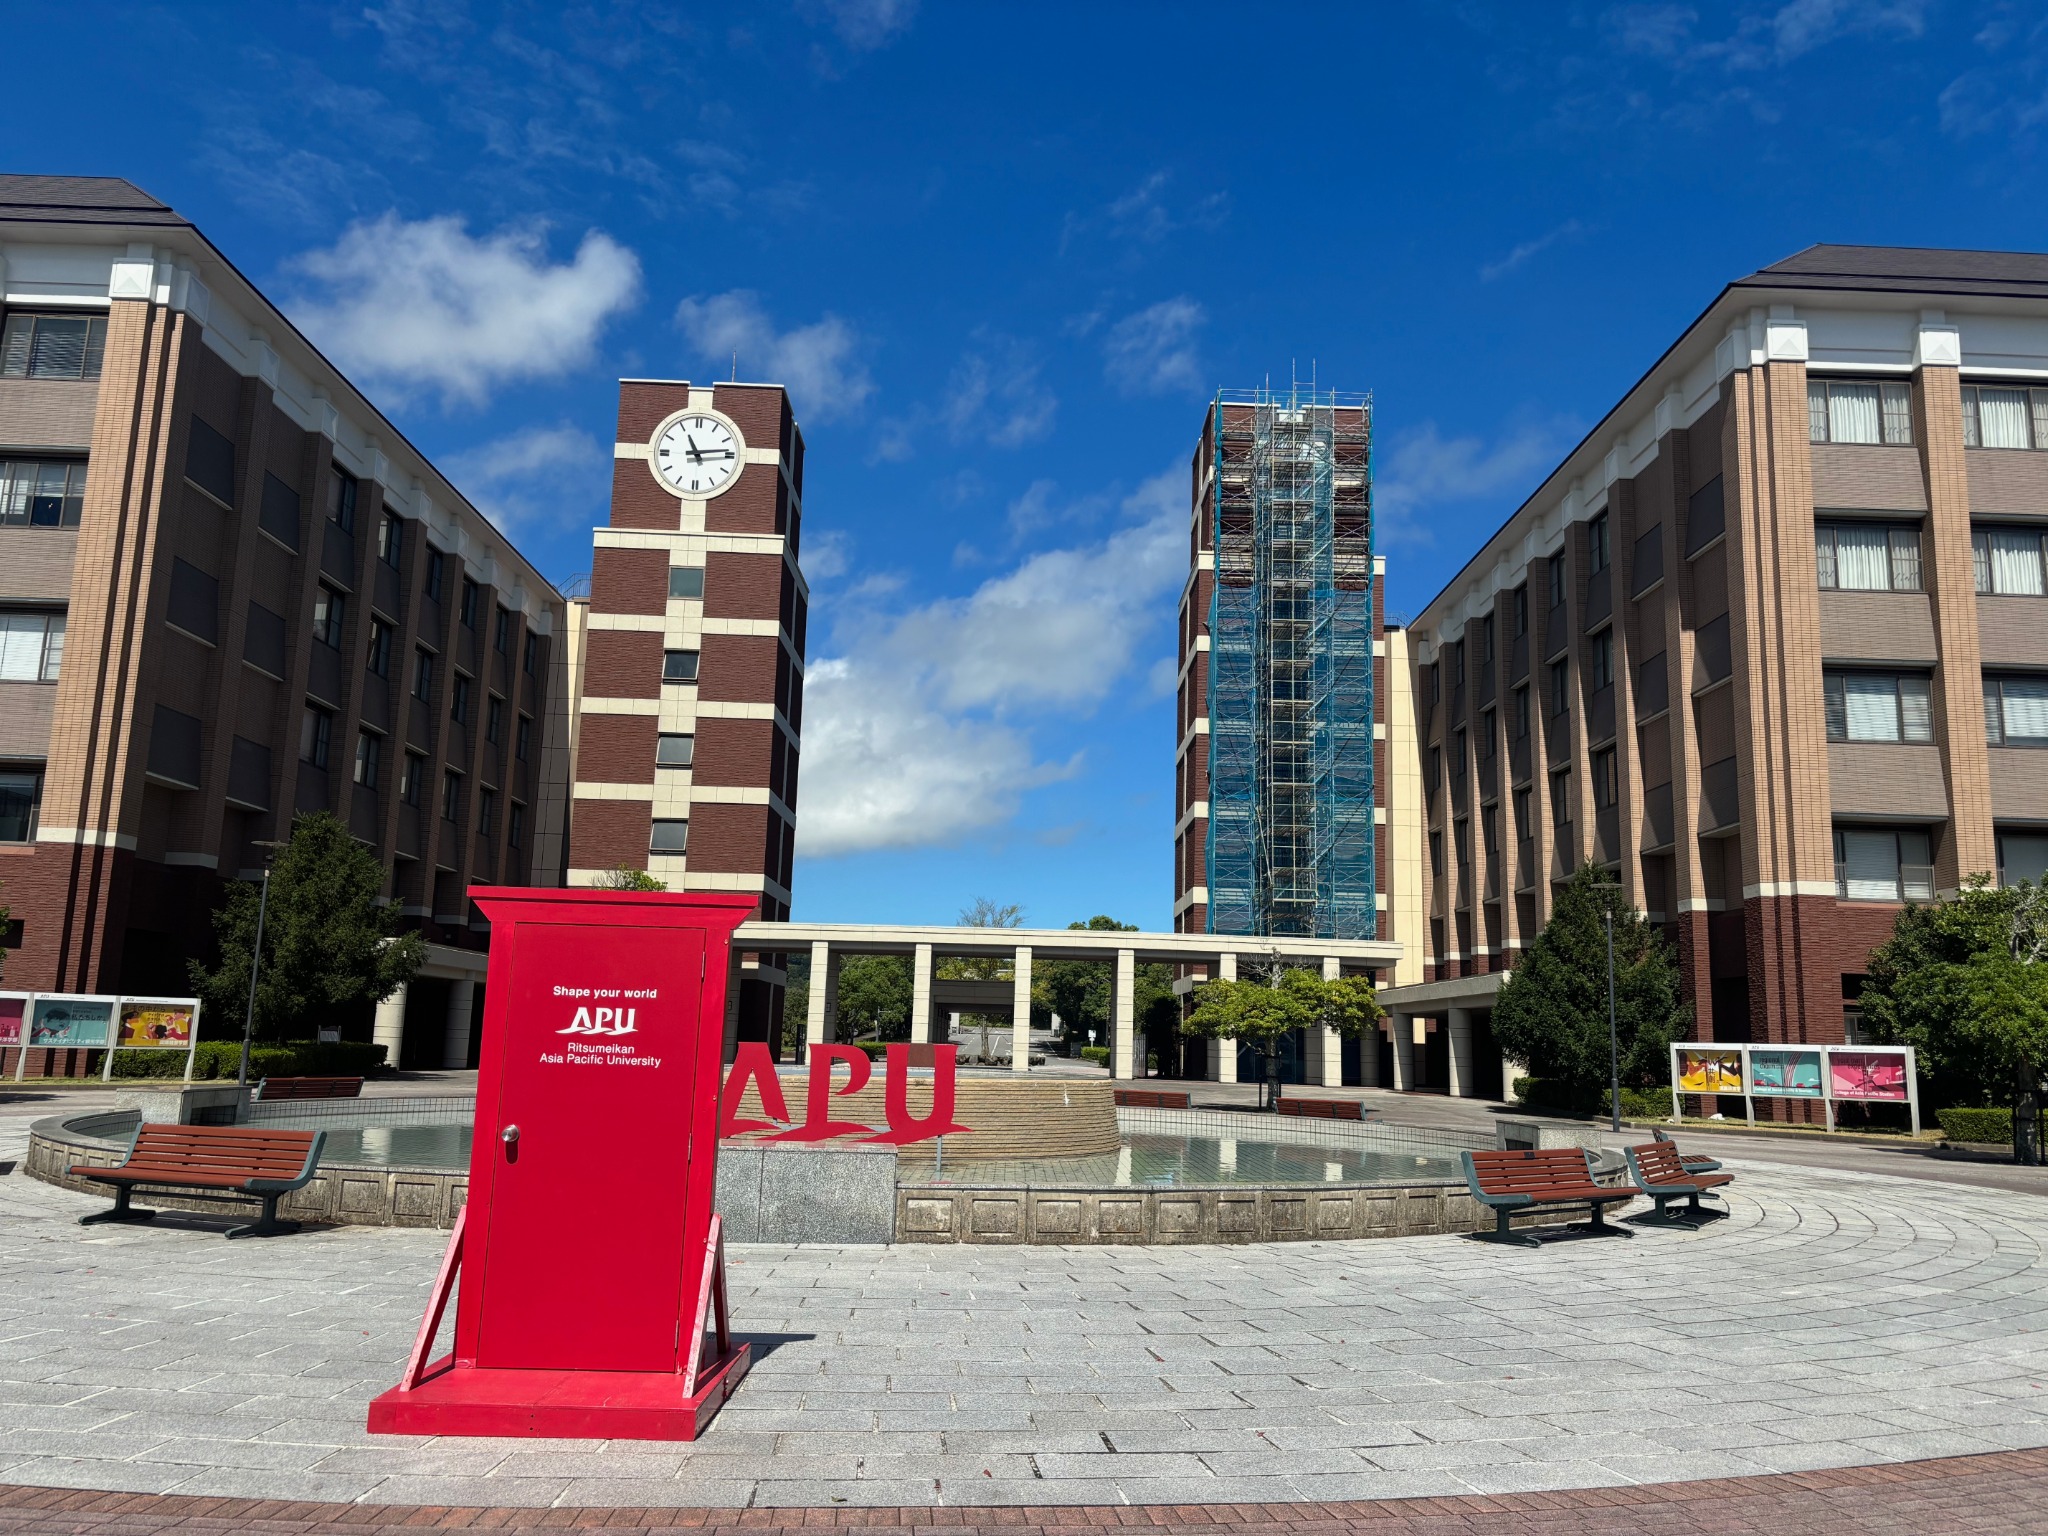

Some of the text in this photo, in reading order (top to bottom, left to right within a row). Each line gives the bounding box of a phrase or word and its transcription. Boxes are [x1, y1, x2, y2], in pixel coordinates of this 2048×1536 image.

[553, 985, 658, 999] Shape your world
[555, 1006, 639, 1036] APU
[567, 1042, 635, 1054] Ritsumeikan
[539, 1052, 662, 1069] Asia Pacific University
[719, 1041, 974, 1146] APU
